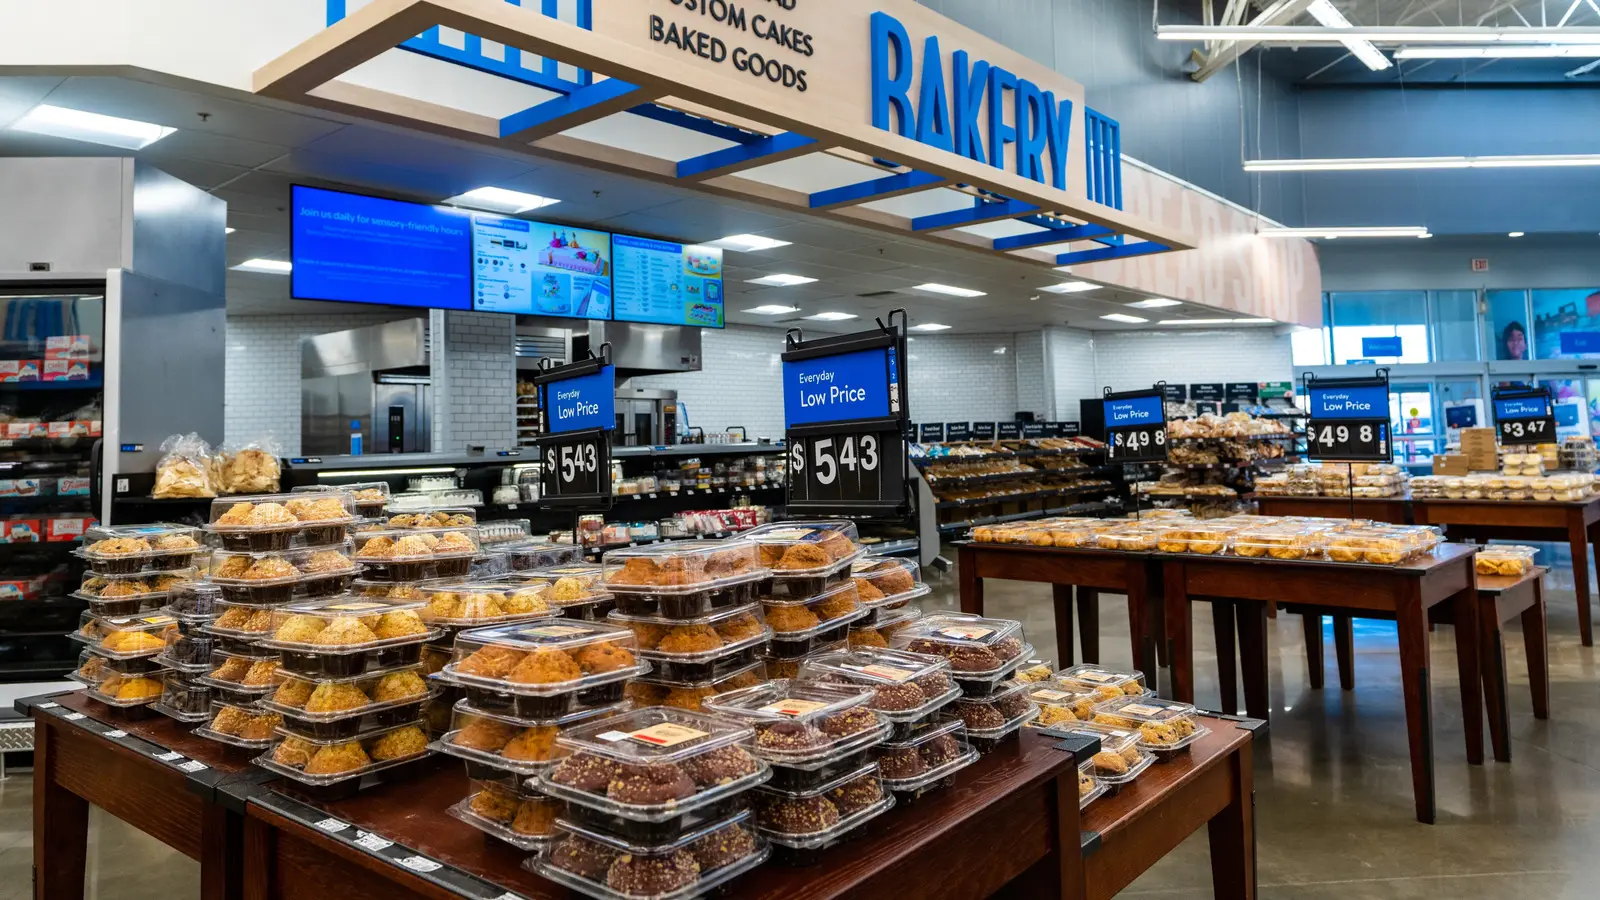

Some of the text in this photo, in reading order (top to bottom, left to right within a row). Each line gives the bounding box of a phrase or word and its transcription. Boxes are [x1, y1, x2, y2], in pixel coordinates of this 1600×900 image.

[752, 14, 814, 57] CAKES
[649, 14, 808, 92] BAKED GOODS
[870, 11, 1073, 192] BAKERY
[299, 207, 464, 236] Join us daily for sensory-friendly hours
[799, 370, 835, 384] Everyday
[557, 389, 581, 401] Everyday
[800, 384, 866, 408] Low Price
[1322, 393, 1349, 401] Everyday
[558, 401, 599, 420] Low Price
[1323, 401, 1371, 411] Low Price
[1505, 405, 1539, 415] Low Price
[1113, 410, 1149, 420] Low Price
